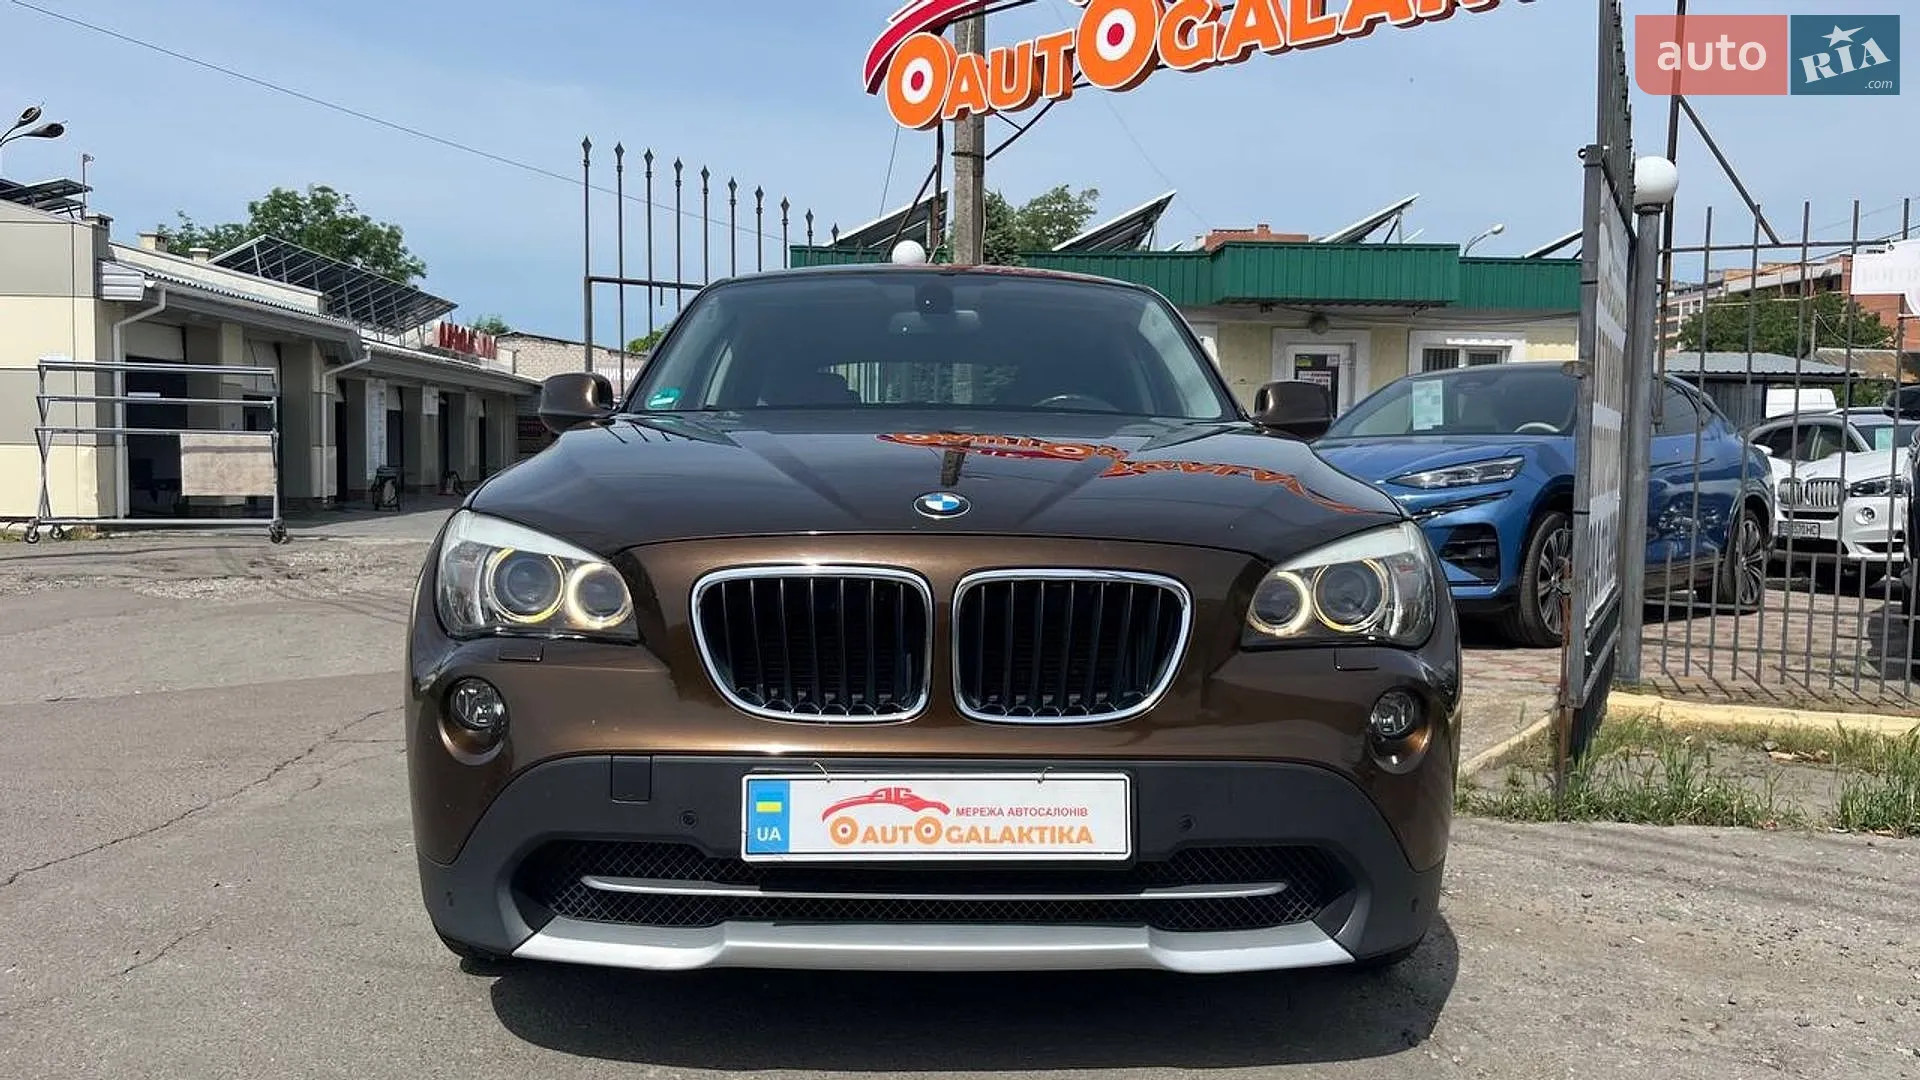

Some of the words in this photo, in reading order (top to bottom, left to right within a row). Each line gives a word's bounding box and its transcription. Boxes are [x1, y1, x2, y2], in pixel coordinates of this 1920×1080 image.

[956, 806, 1004, 817] МЕРЕЖА
[1008, 806, 1089, 817] АВТОСАЛОНІВ
[757, 827, 782, 842] UA
